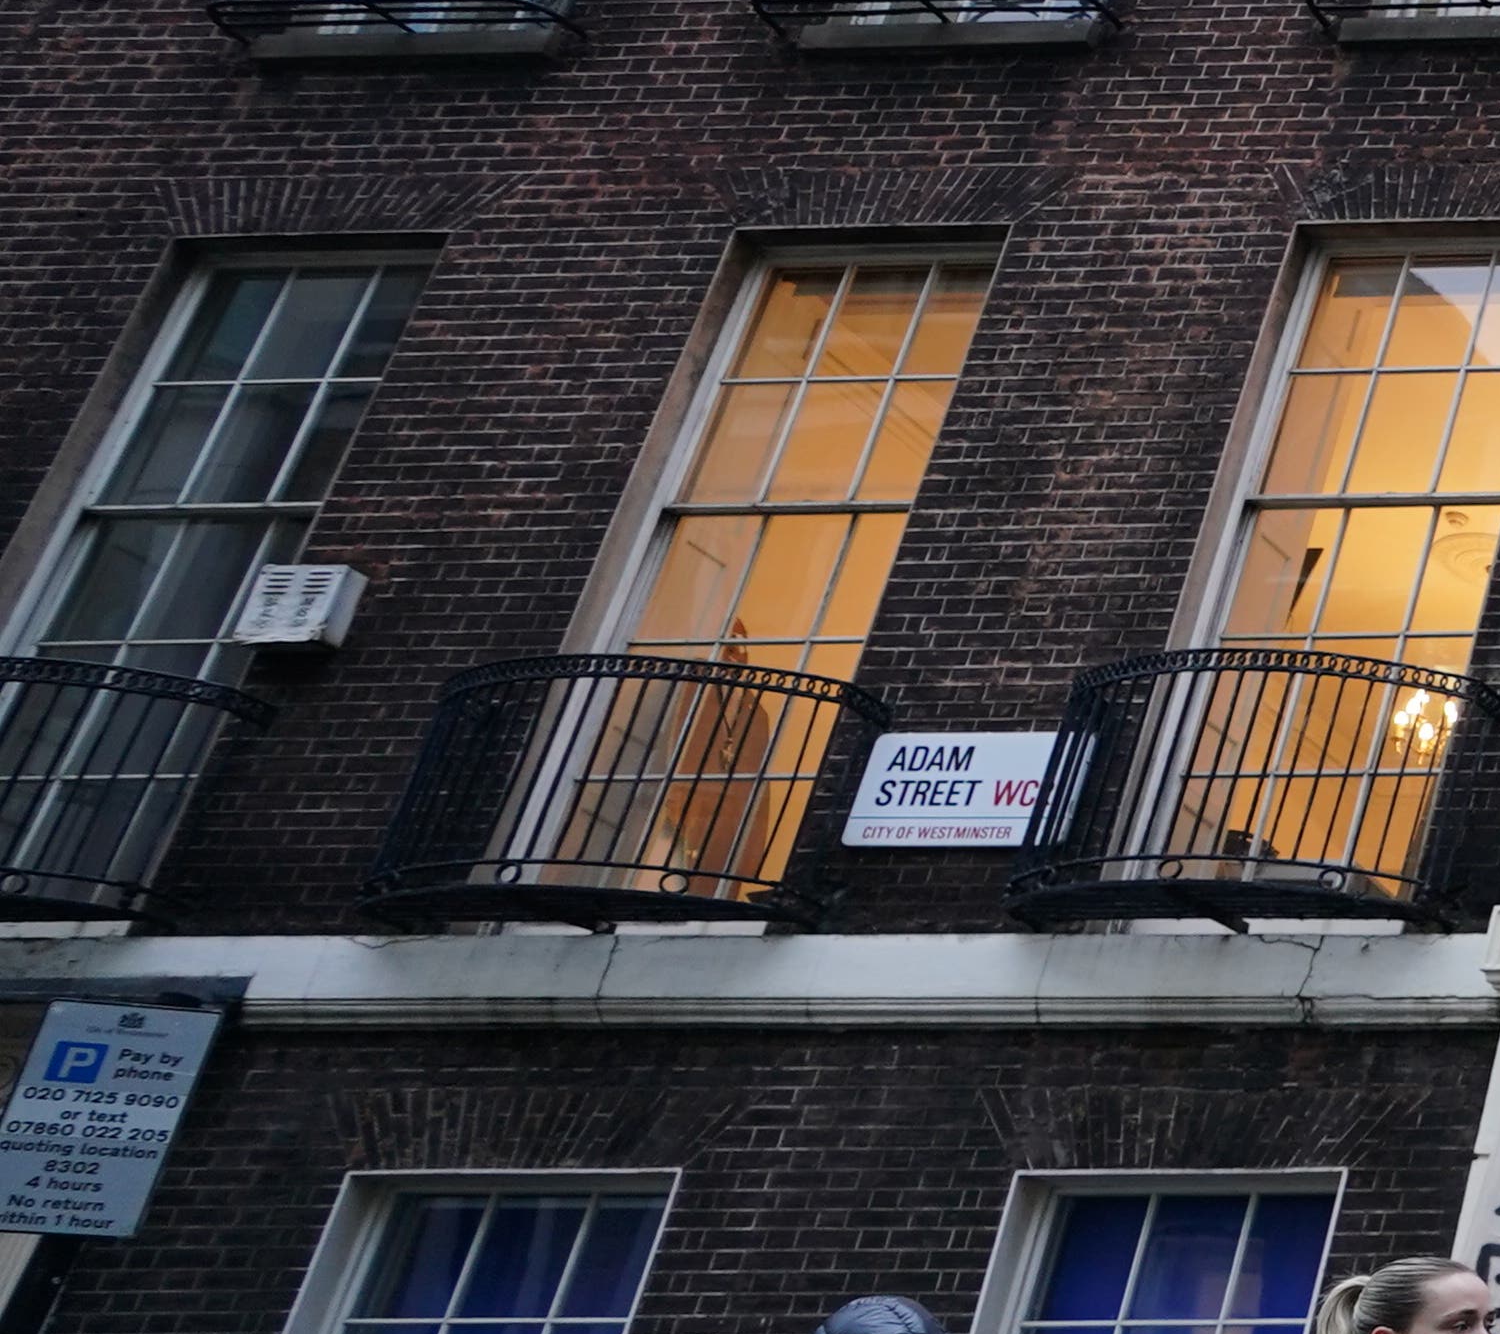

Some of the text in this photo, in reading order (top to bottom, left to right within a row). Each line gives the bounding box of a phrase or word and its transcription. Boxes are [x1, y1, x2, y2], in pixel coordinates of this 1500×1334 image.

[887, 746, 976, 772] ADAM
[875, 780, 1048, 807] STREET WC
[862, 826, 1013, 840] CITY OF WESTMINSTER
[118, 1048, 184, 1067] Pay by
[112, 1066, 175, 1082] phone
[23, 1086, 180, 1109] 020 7125 9090
[60, 1109, 129, 1124] or text
[6, 1120, 171, 1143] 07860 022 205
[0, 1139, 159, 1159] quoting location
[43, 1159, 101, 1175] 8302
[25, 1175, 104, 1192] 4 hours
[7, 1194, 106, 1212] No return
[54, 1214, 63, 1227] 1
[69, 1215, 114, 1229] hour
